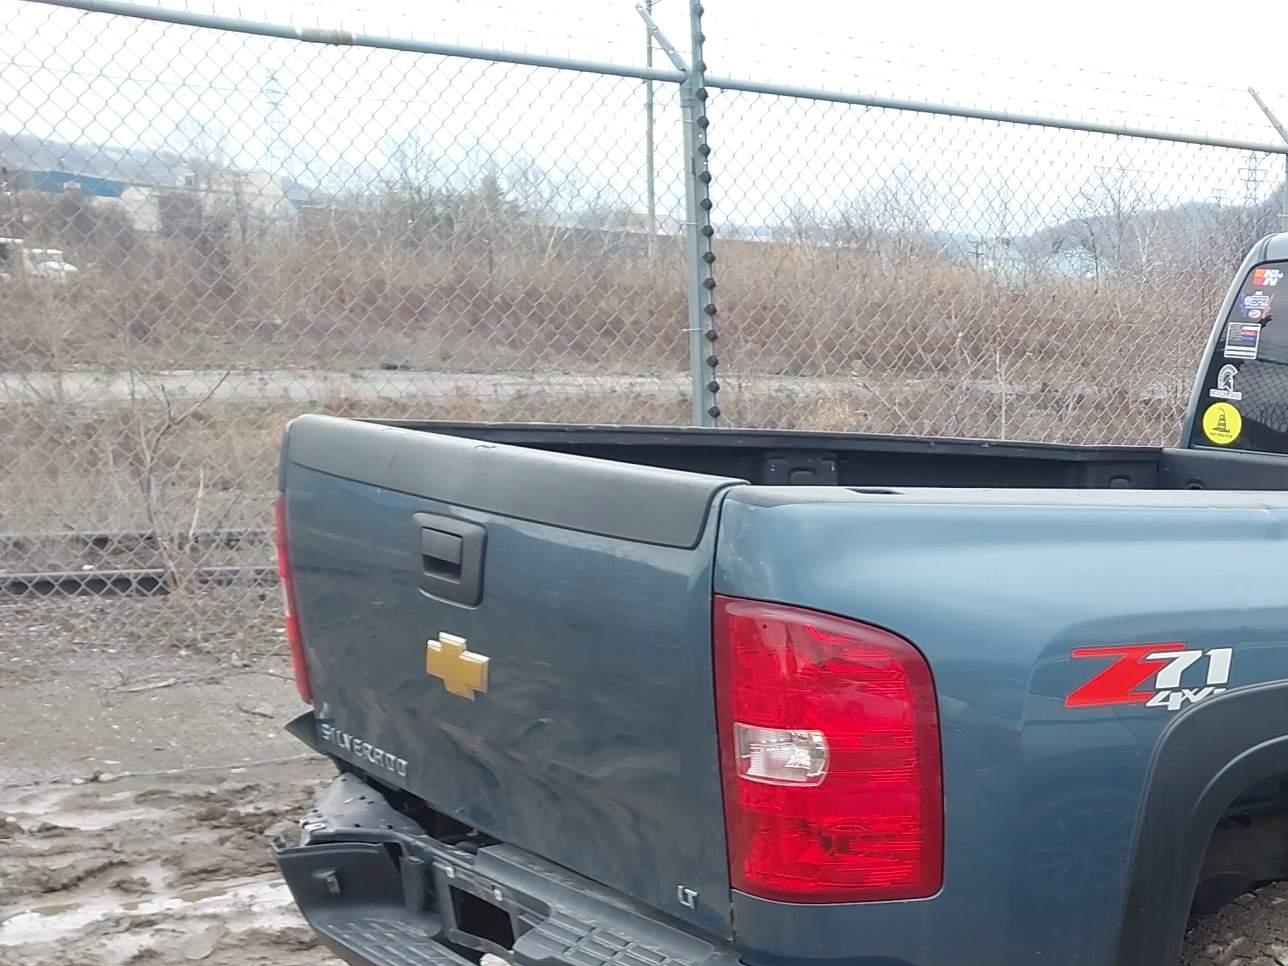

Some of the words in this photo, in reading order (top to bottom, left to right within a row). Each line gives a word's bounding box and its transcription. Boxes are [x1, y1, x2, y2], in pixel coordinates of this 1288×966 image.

[1064, 640, 1233, 708] Z71
[320, 723, 409, 778] SILVERADO
[675, 884, 700, 910] LT
